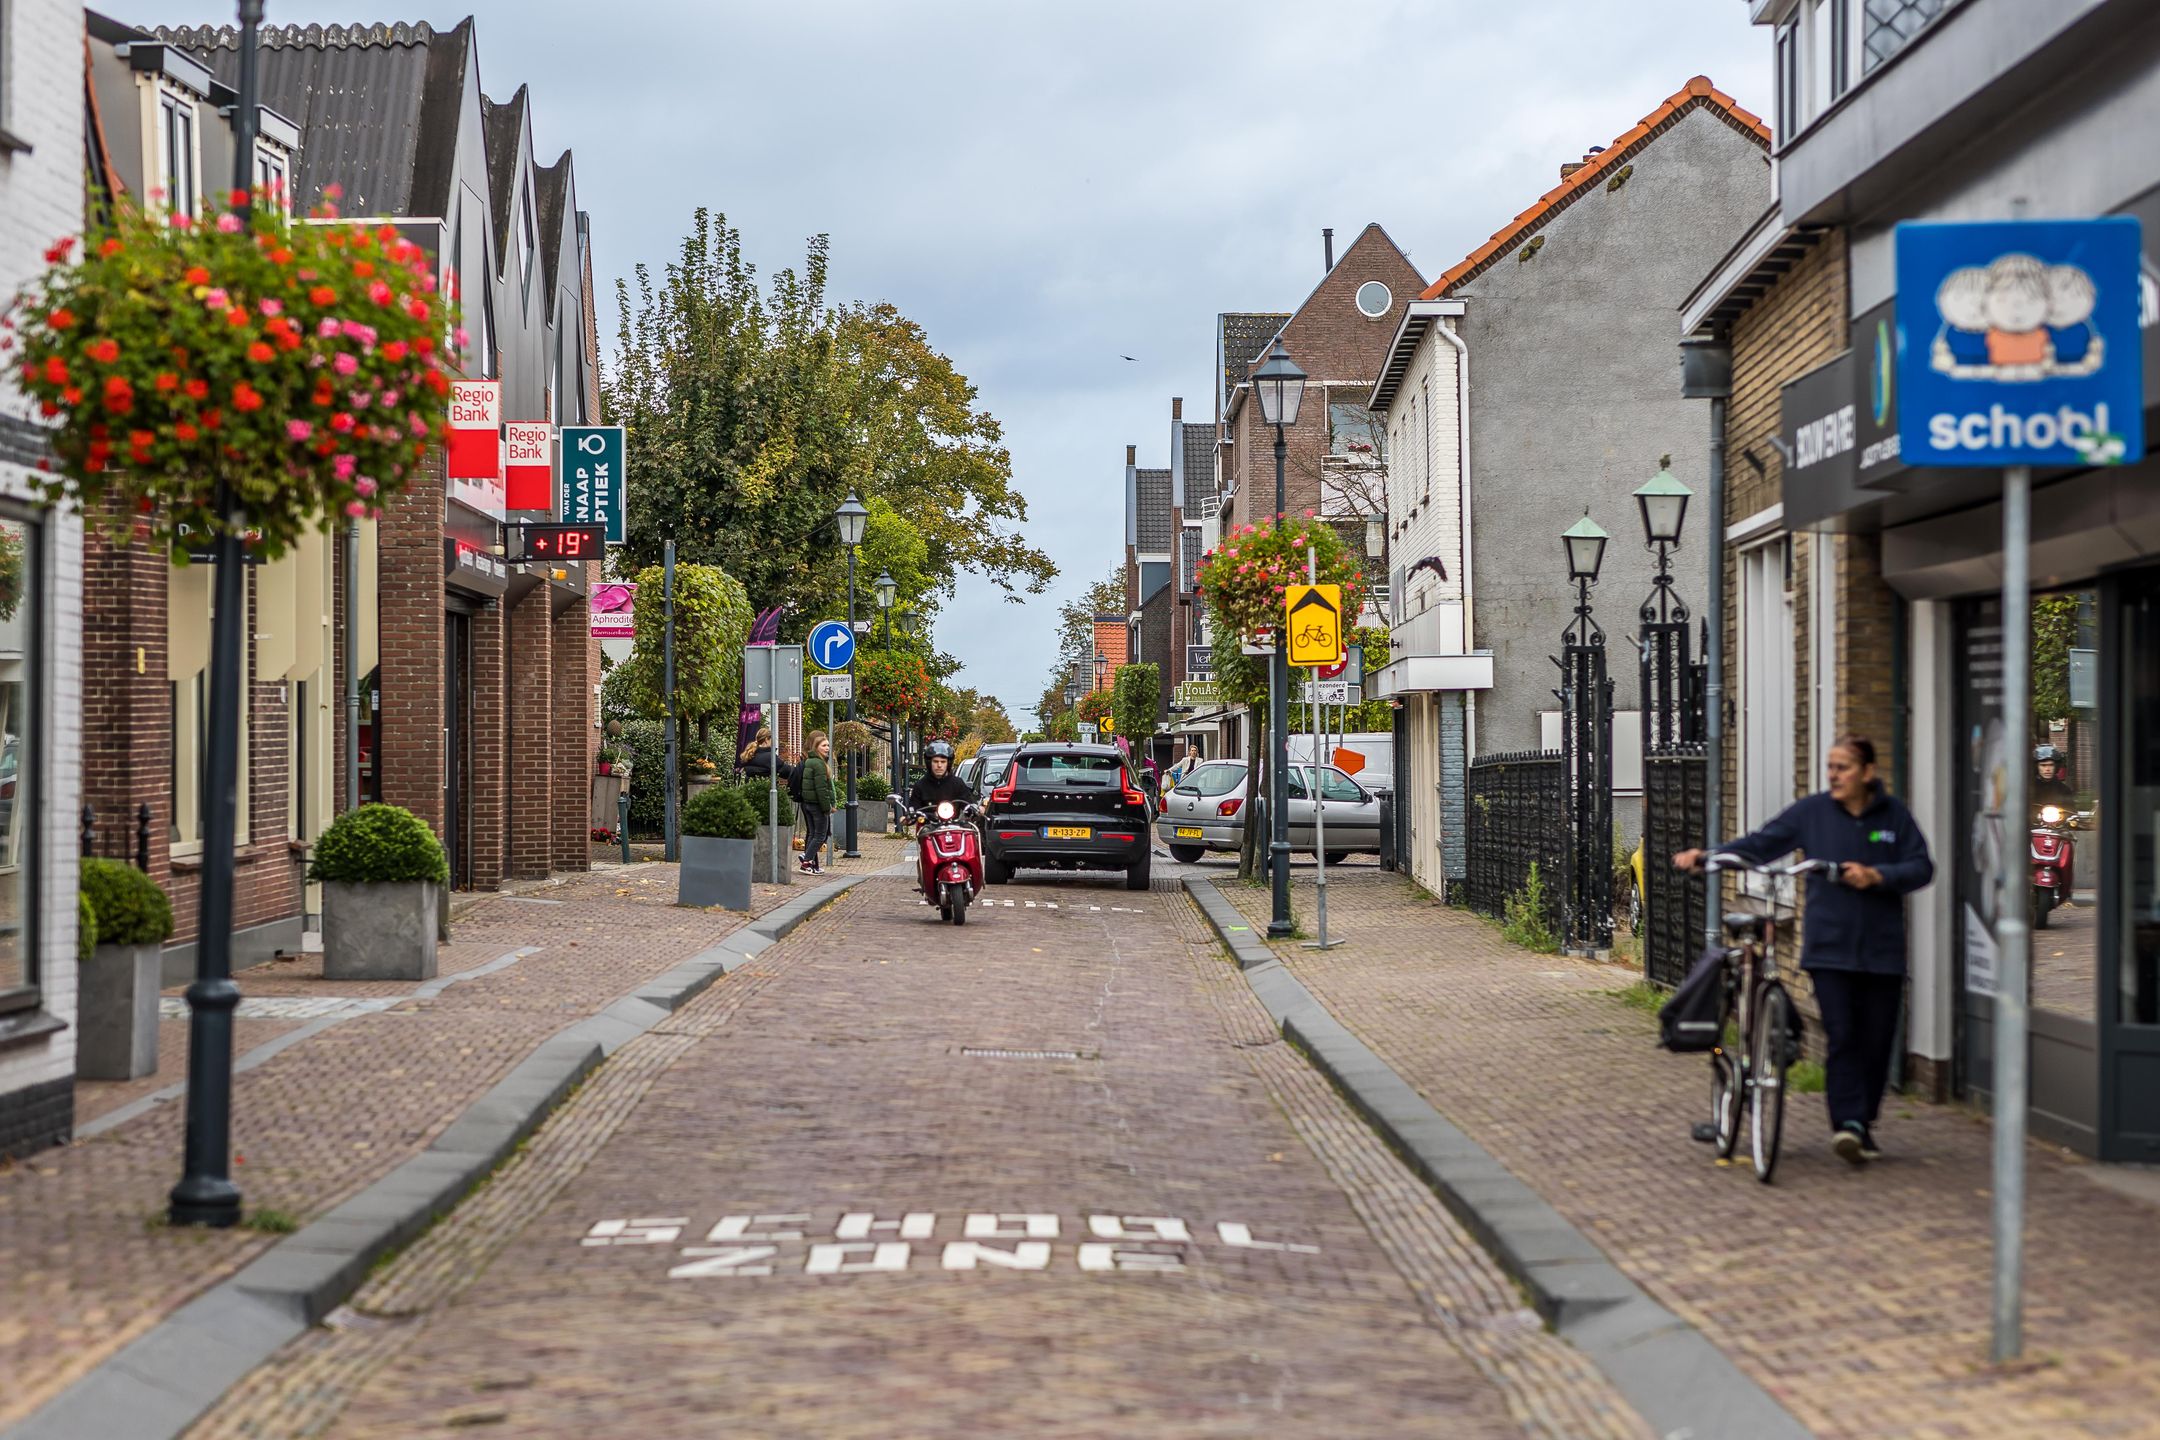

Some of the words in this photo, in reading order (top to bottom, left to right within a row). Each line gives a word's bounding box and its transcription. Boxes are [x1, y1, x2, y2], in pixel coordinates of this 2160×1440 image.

[452, 386, 494, 406] Regio
[452, 405, 489, 422] Bank
[509, 426, 547, 446] Regio
[1928, 402, 2110, 450] school
[509, 444, 542, 459] Bank
[576, 467, 589, 523] NAAP
[594, 462, 609, 533] PTIEK
[1184, 683, 1220, 695] YouAs
[1052, 828, 1086, 837] R-133-ZP
[667, 1241, 1187, 1279] ZONE
